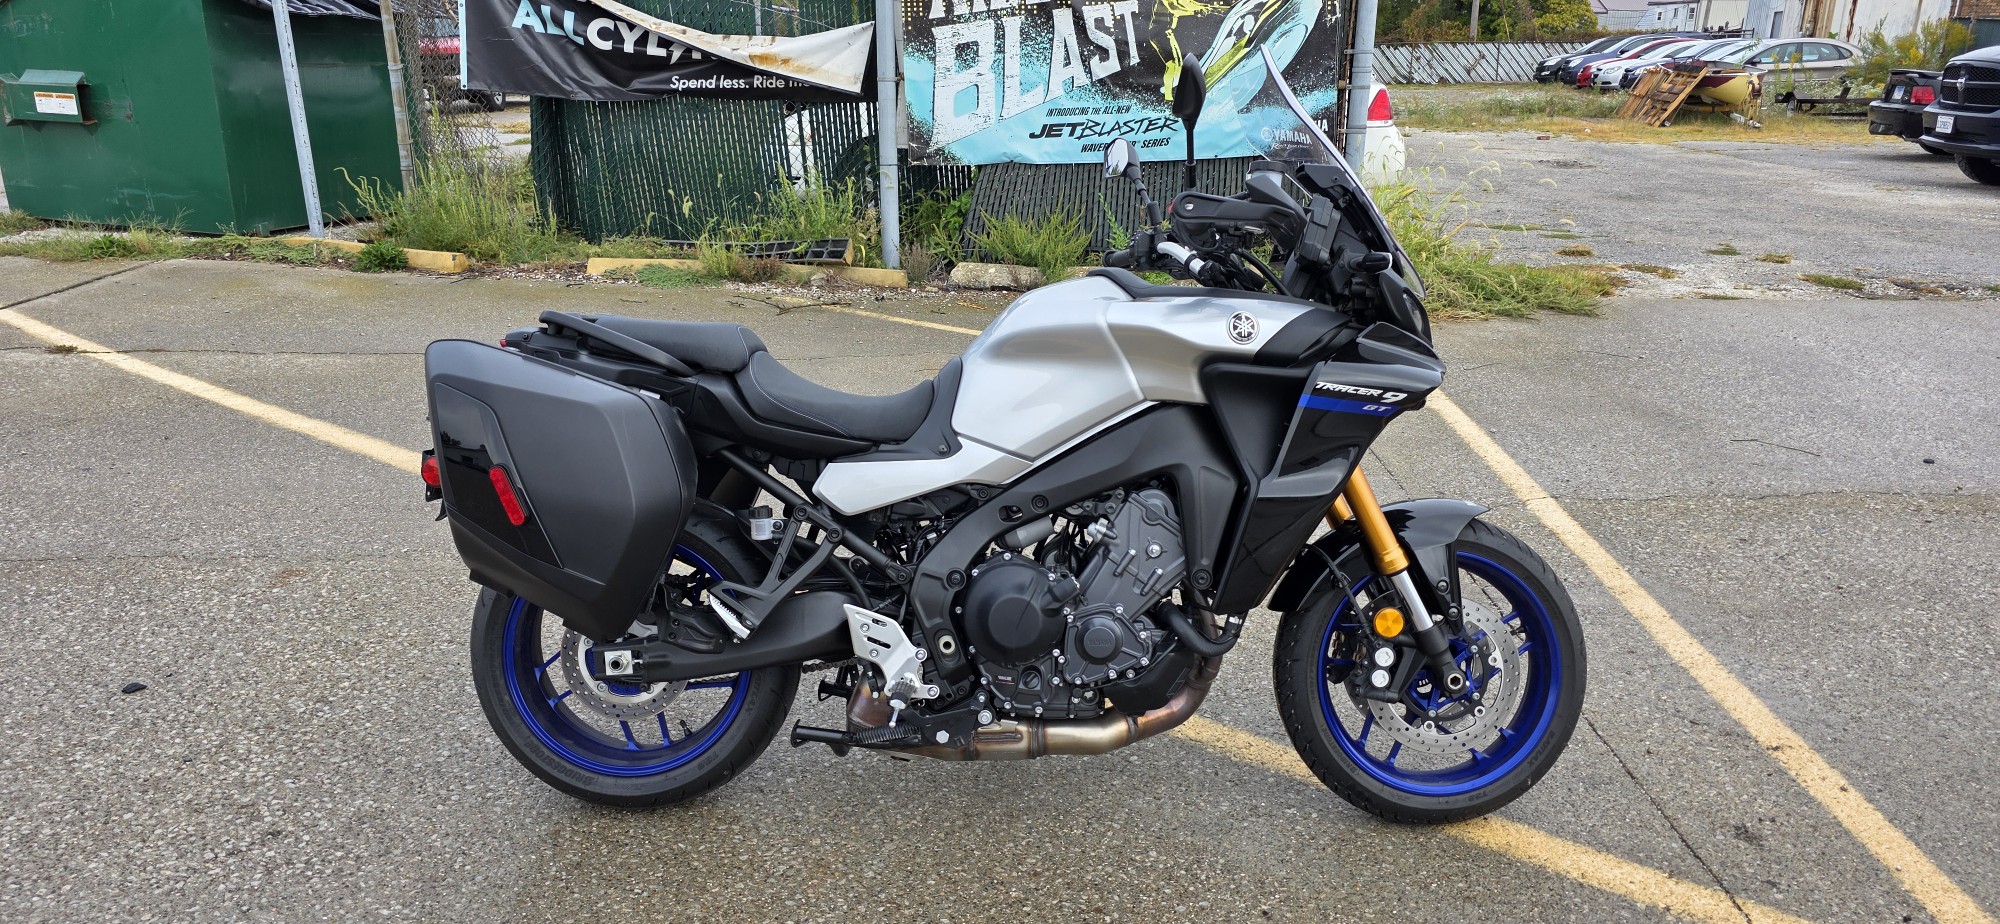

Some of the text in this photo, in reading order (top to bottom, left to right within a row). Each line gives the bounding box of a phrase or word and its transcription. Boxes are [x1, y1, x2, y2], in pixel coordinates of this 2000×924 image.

[929, 0, 1141, 148] BLAST
[670, 75, 717, 91] Spend
[719, 75, 750, 89] less.
[753, 75, 785, 88] Ride
[1046, 104, 1132, 117] INTRODUCING THE ALL-NEW
[1029, 117, 1180, 141] JETBLASTER
[1274, 128, 1312, 145] YAMAHA
[1141, 137, 1171, 148] SERIES
[1315, 381, 1408, 403] TRACER 9
[1362, 404, 1392, 412] GT
